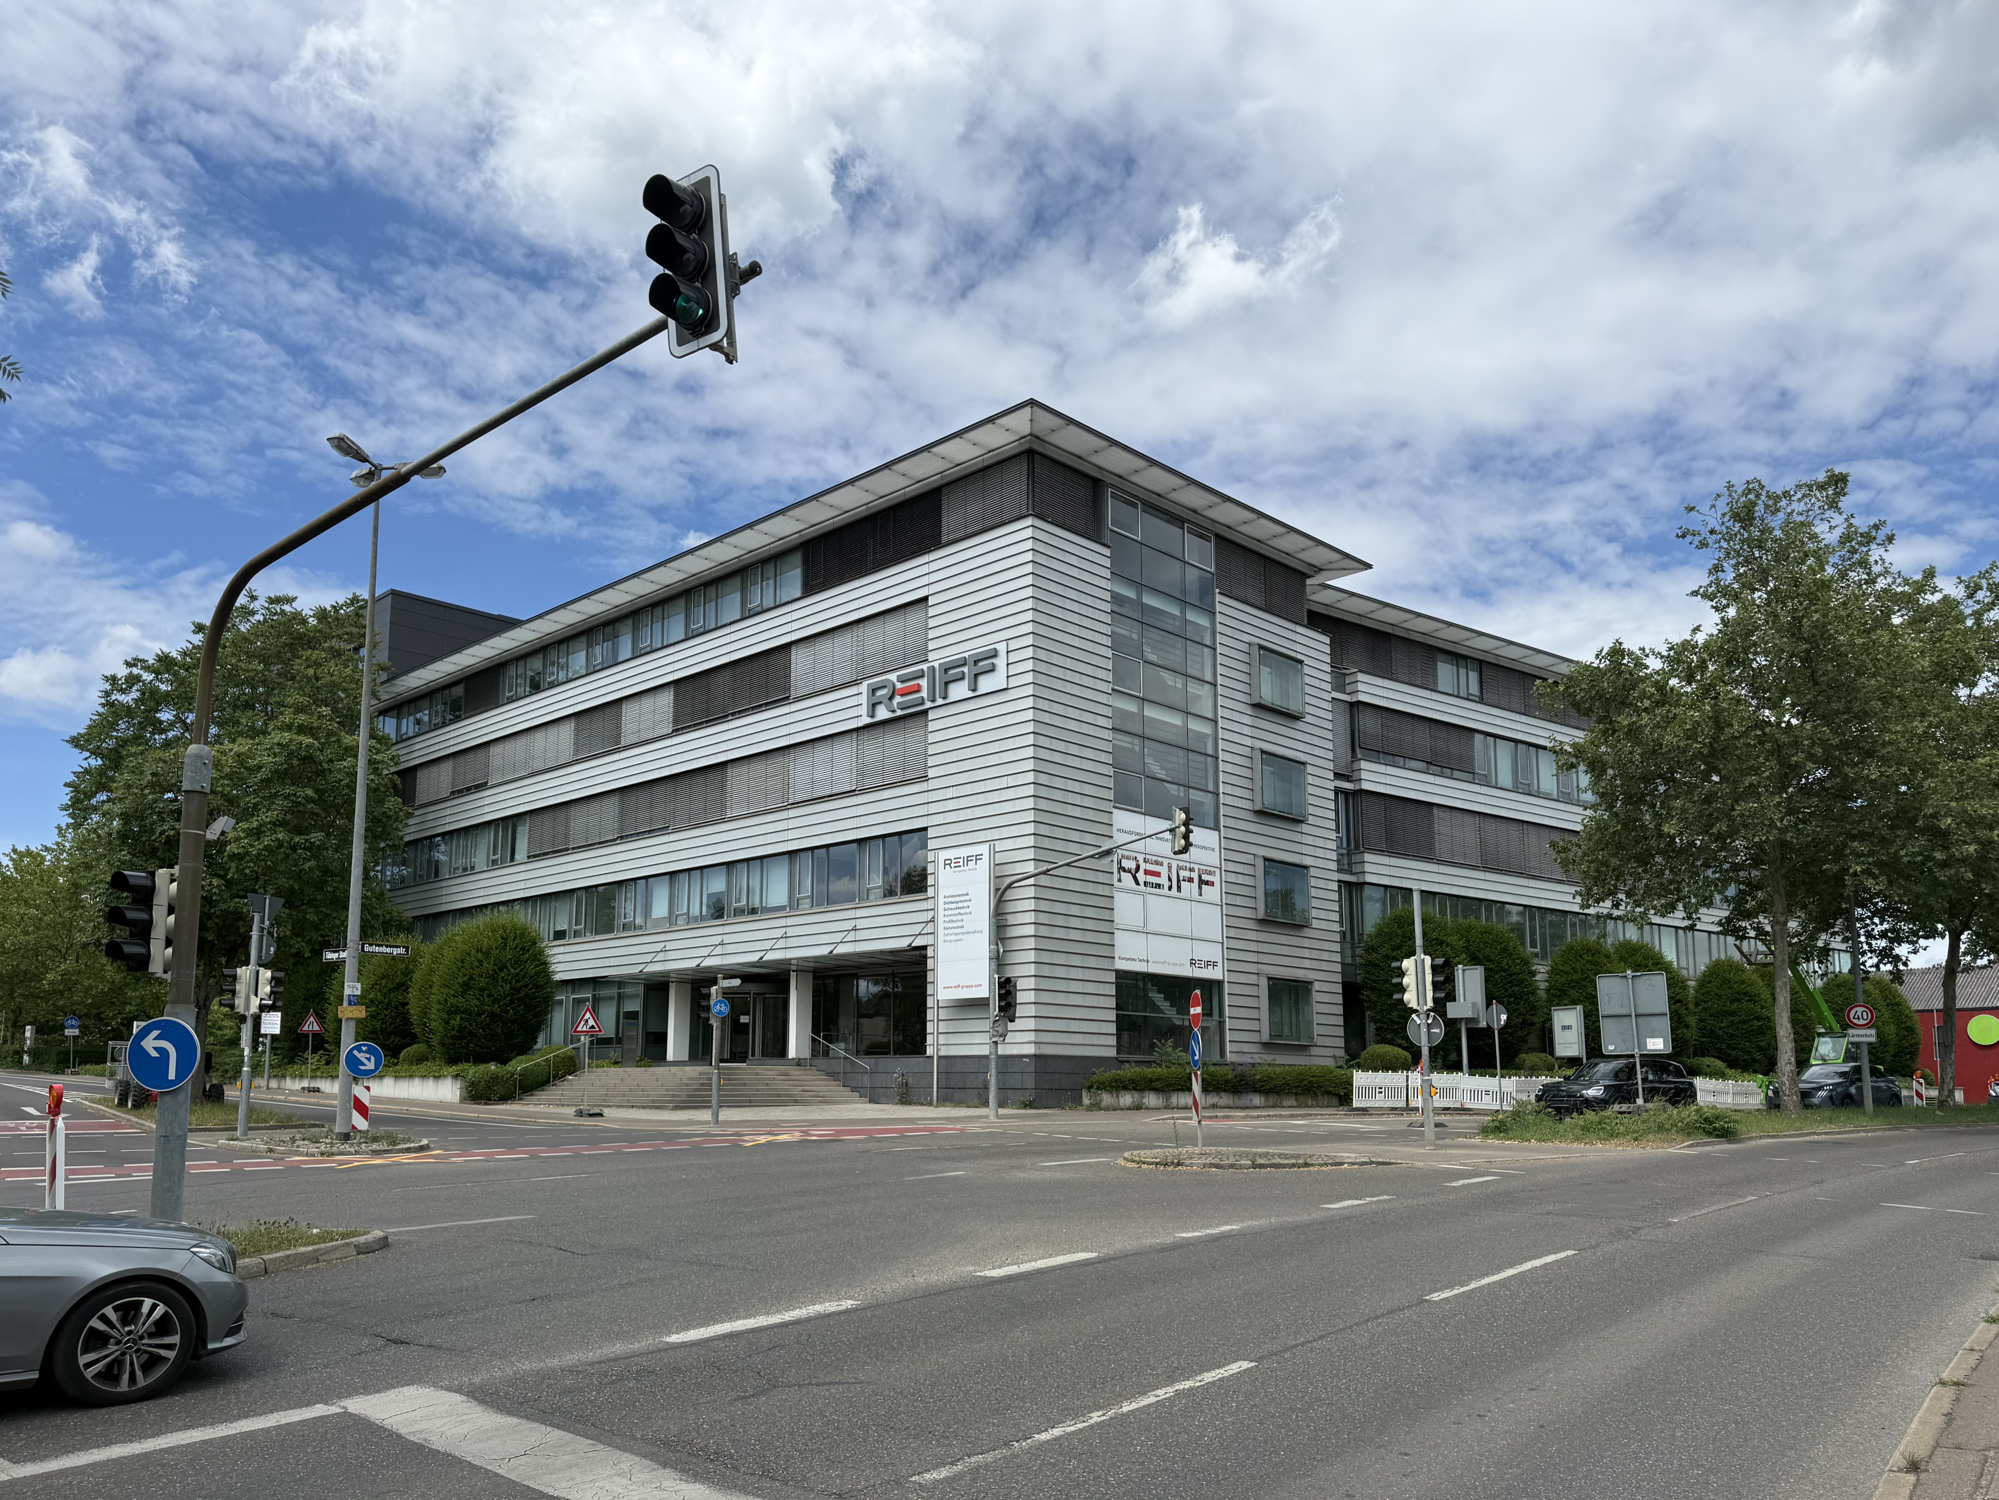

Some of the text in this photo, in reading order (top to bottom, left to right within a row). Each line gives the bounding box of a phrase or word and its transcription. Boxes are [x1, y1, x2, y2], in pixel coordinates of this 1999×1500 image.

[867, 647, 998, 718] REIFF
[943, 853, 984, 870] REIFF
[1117, 852, 1216, 897] REIFF
[364, 943, 407, 956] Gutenbergstr.
[1189, 958, 1219, 971] REIFF
[1852, 1010, 1869, 1021] 40
